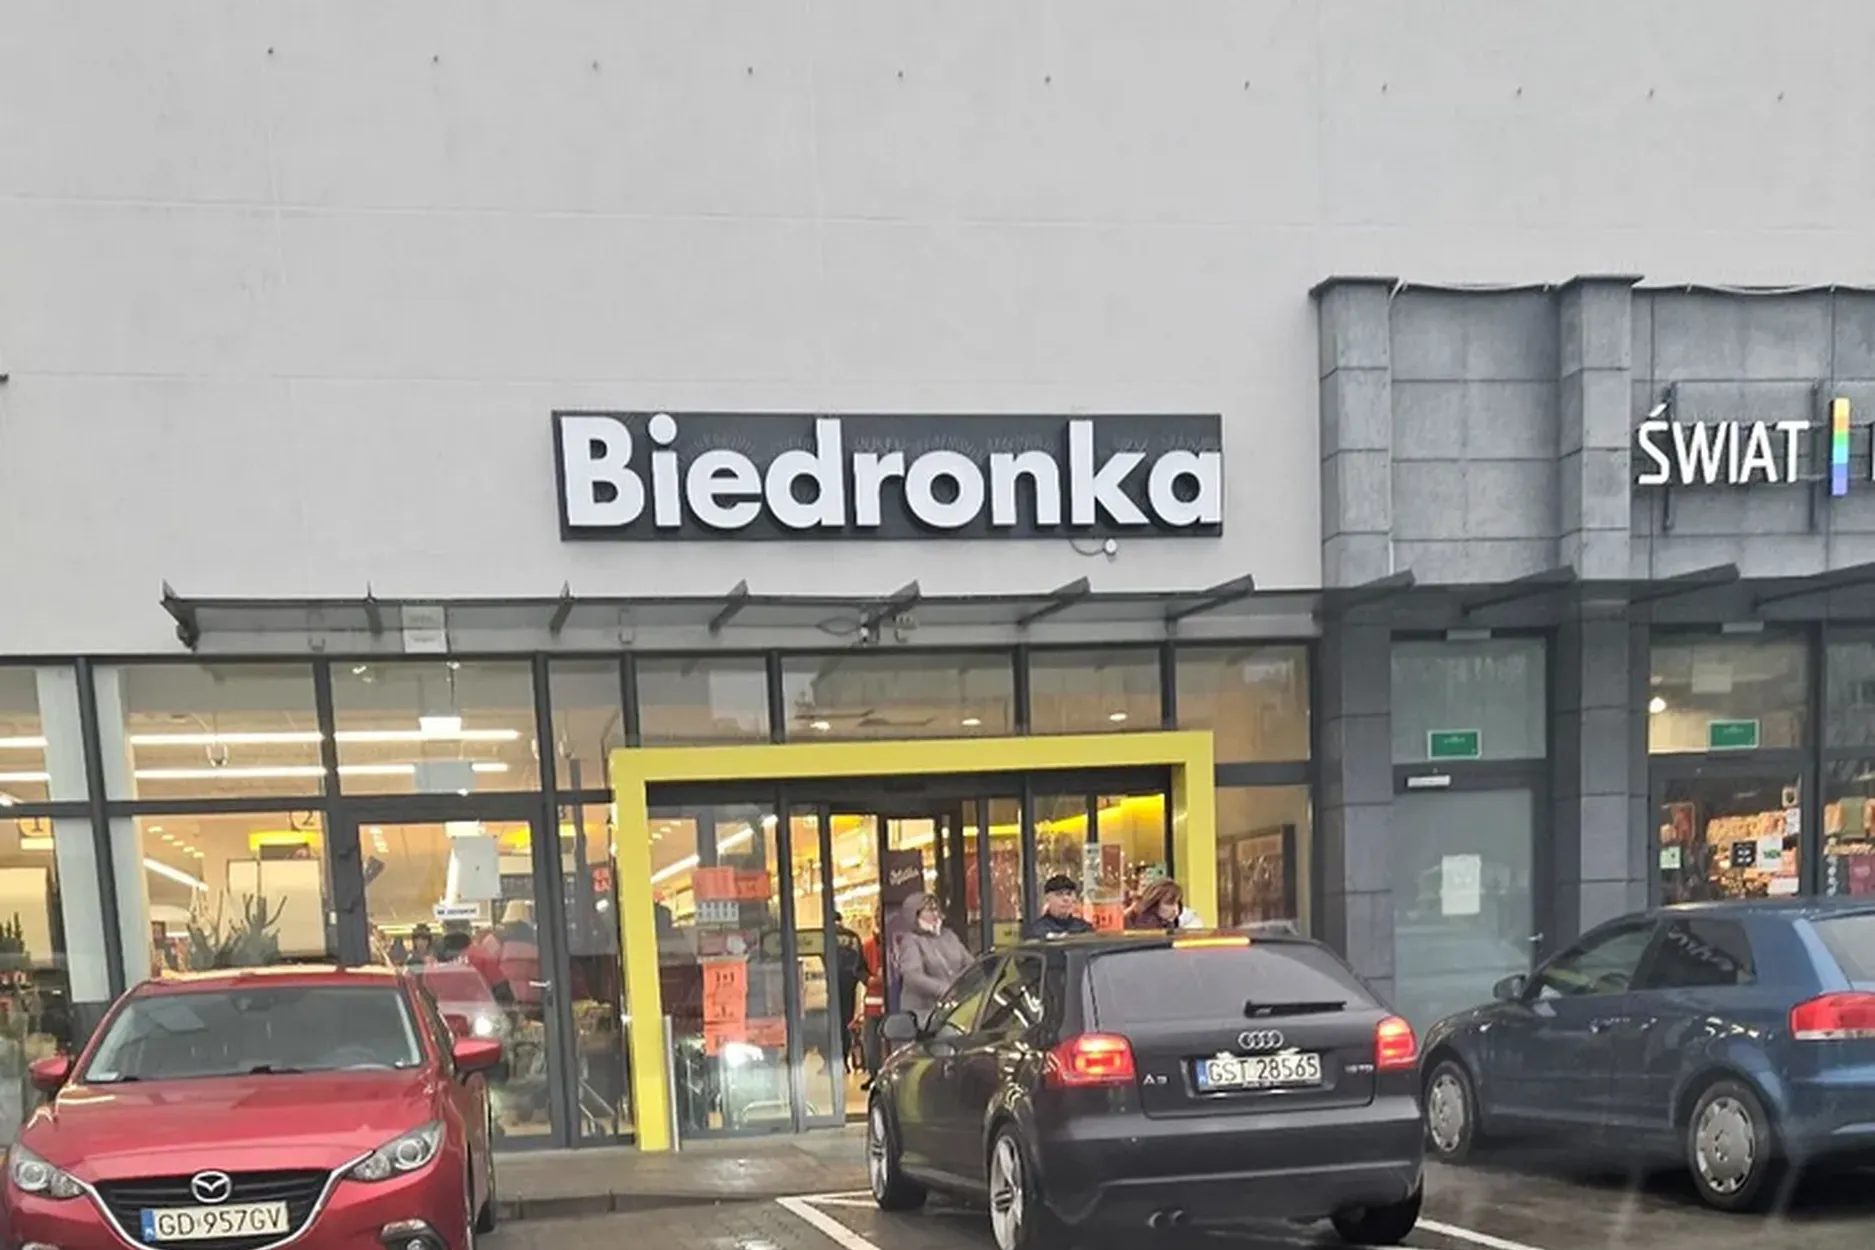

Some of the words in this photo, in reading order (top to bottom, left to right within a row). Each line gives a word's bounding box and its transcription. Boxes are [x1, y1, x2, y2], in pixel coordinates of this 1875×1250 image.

[560, 412, 1223, 530] Biedronka
[1637, 403, 1810, 485] ŚWIAT
[1208, 1060, 1248, 1082] GST
[1256, 1055, 1319, 1080] 28565
[158, 1213, 195, 1236] GD
[203, 1207, 282, 1234] 957GV
